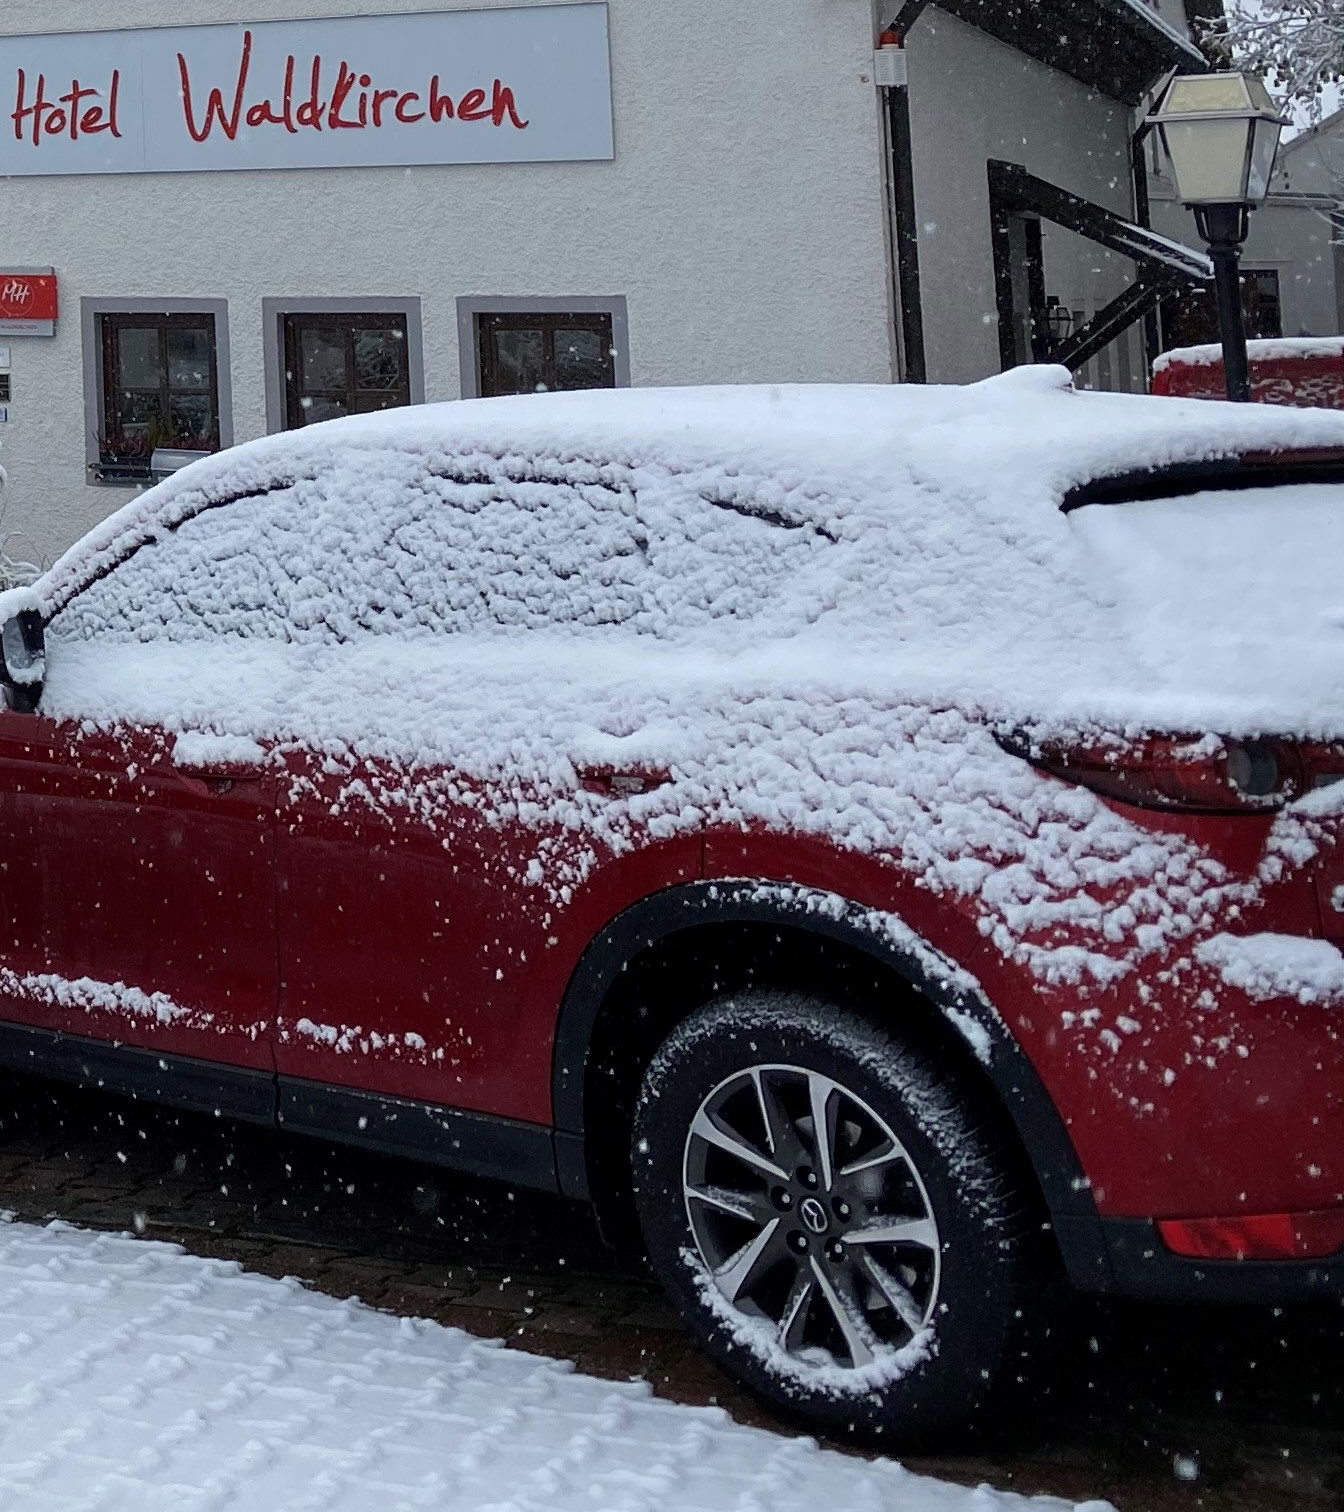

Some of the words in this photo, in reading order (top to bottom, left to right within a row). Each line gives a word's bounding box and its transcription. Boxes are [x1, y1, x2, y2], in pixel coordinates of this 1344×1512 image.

[10, 68, 122, 146] Hotel
[176, 31, 530, 143] Waldkirchen
[1, 279, 31, 304] MH
